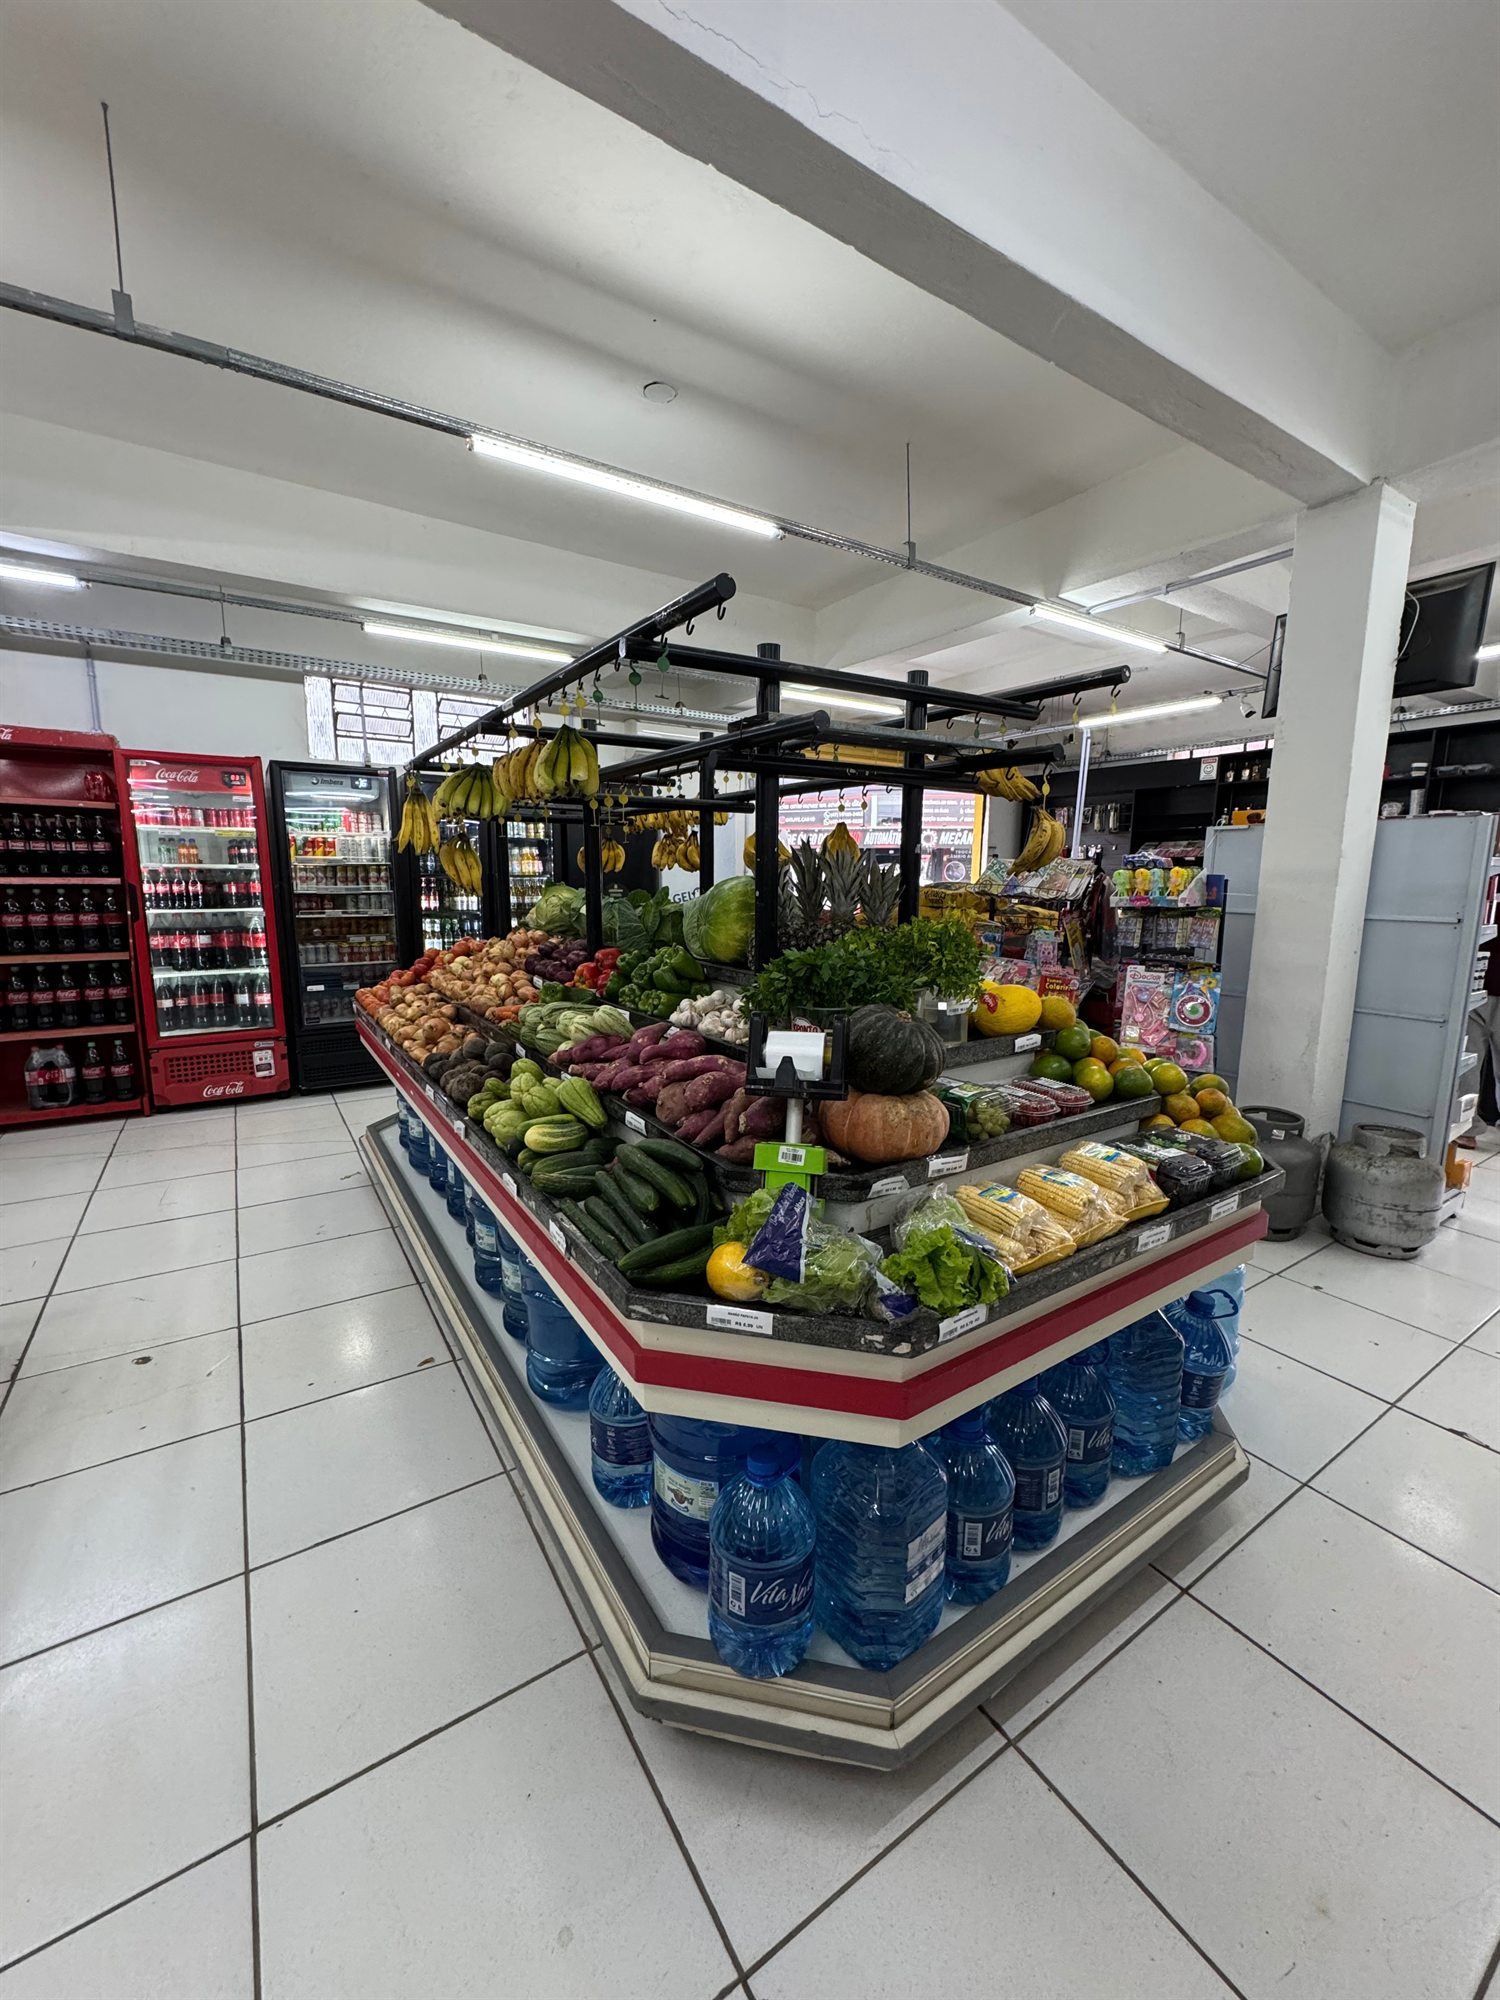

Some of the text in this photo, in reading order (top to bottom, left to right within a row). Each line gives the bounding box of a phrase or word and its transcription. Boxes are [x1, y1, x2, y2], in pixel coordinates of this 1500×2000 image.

[155, 768, 200, 783] Coca-Cola
[203, 1081, 244, 1098] Coca-Cola
[750, 1577, 786, 1605] Vita
